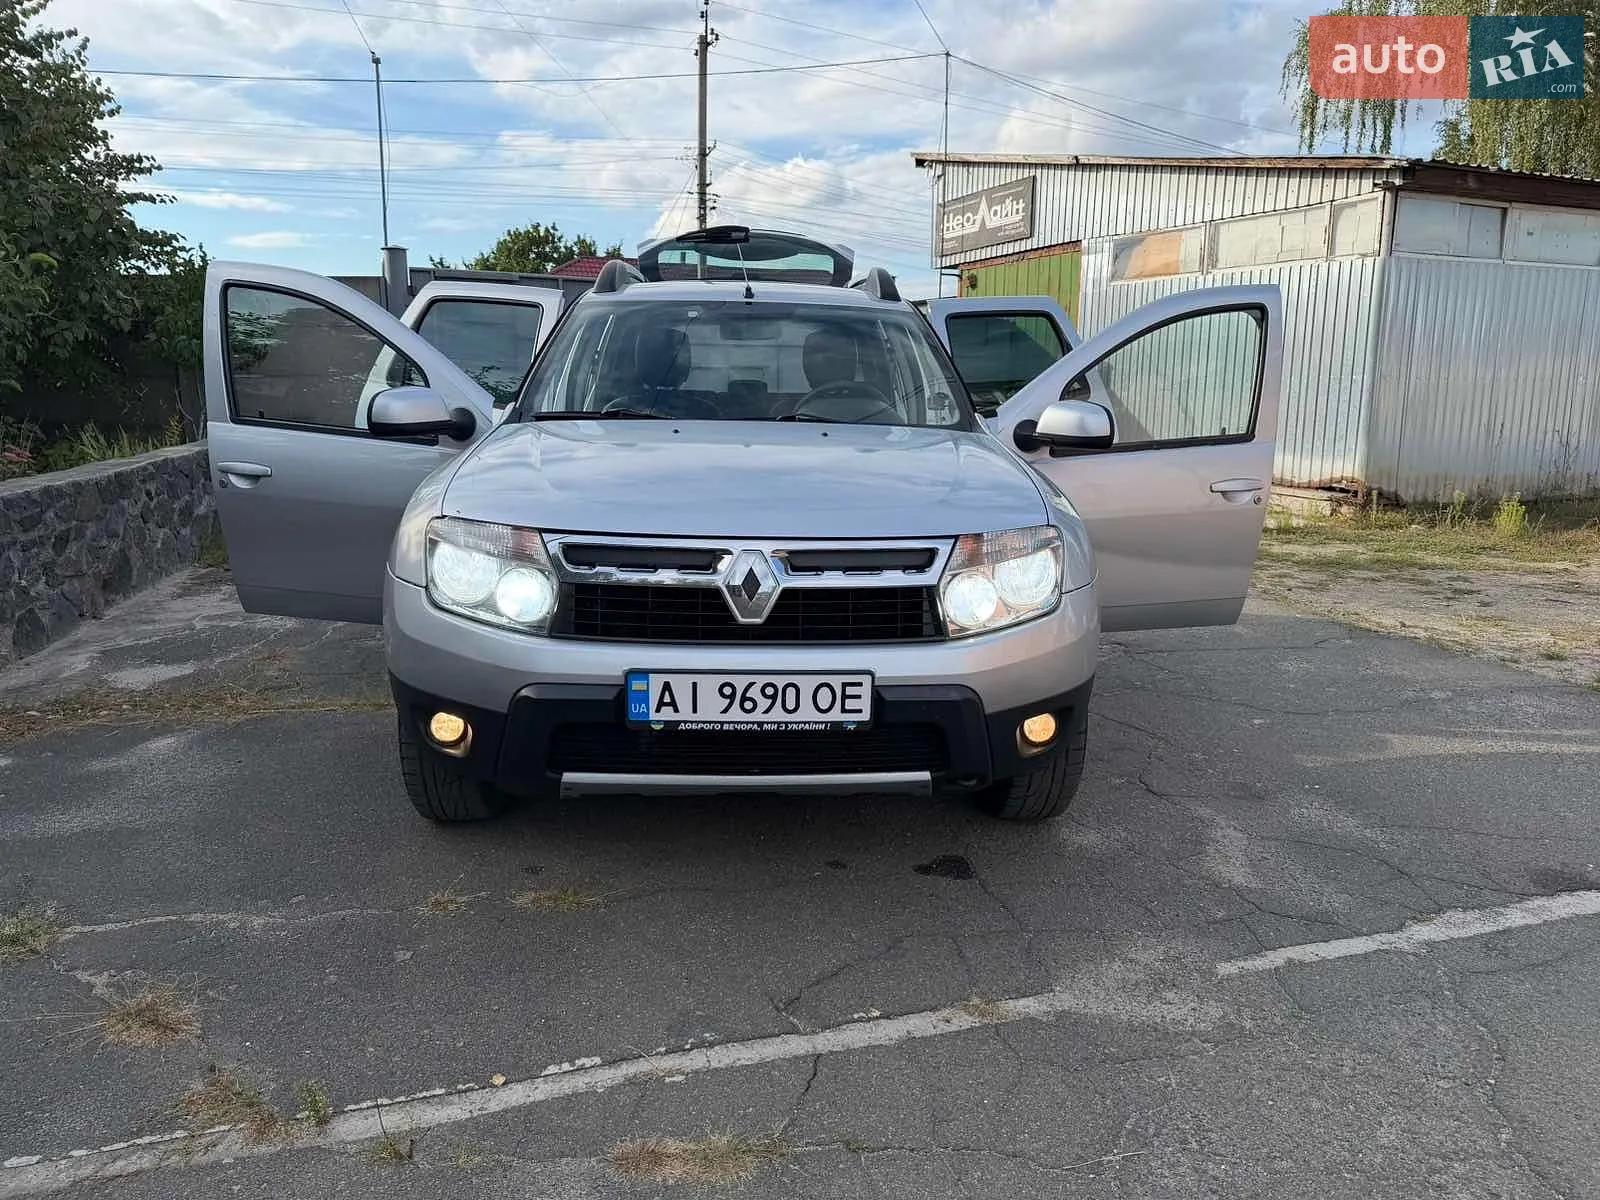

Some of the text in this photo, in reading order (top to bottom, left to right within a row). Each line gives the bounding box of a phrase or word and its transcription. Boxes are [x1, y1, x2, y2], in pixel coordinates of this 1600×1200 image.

[654, 680, 864, 714] AI 9690 OE
[631, 703, 648, 713] UA
[678, 722, 721, 731] ДОБРОГО
[722, 722, 760, 732] ВЕЧОРА,
